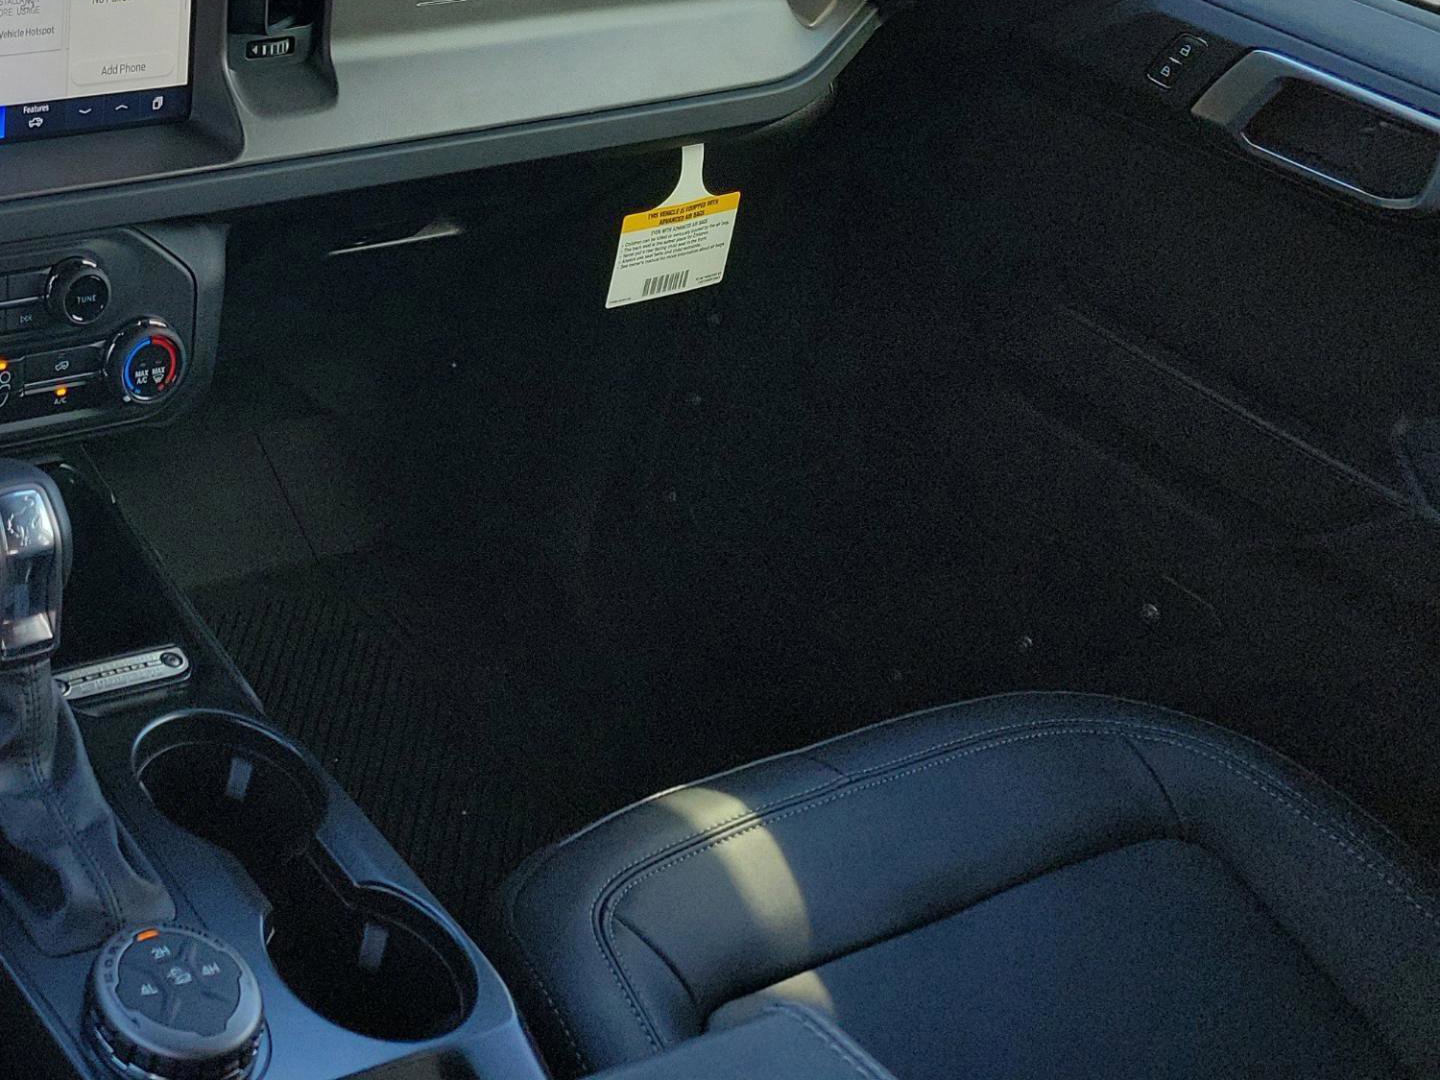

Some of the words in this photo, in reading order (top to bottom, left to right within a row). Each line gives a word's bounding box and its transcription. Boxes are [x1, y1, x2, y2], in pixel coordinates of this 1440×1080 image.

[0, 28, 24, 40] Vehicle
[25, 25, 55, 38] Hotspot
[100, 64, 118, 76] Add
[119, 62, 147, 75] Phone
[23, 103, 49, 115] Features
[77, 294, 97, 304] TUNE
